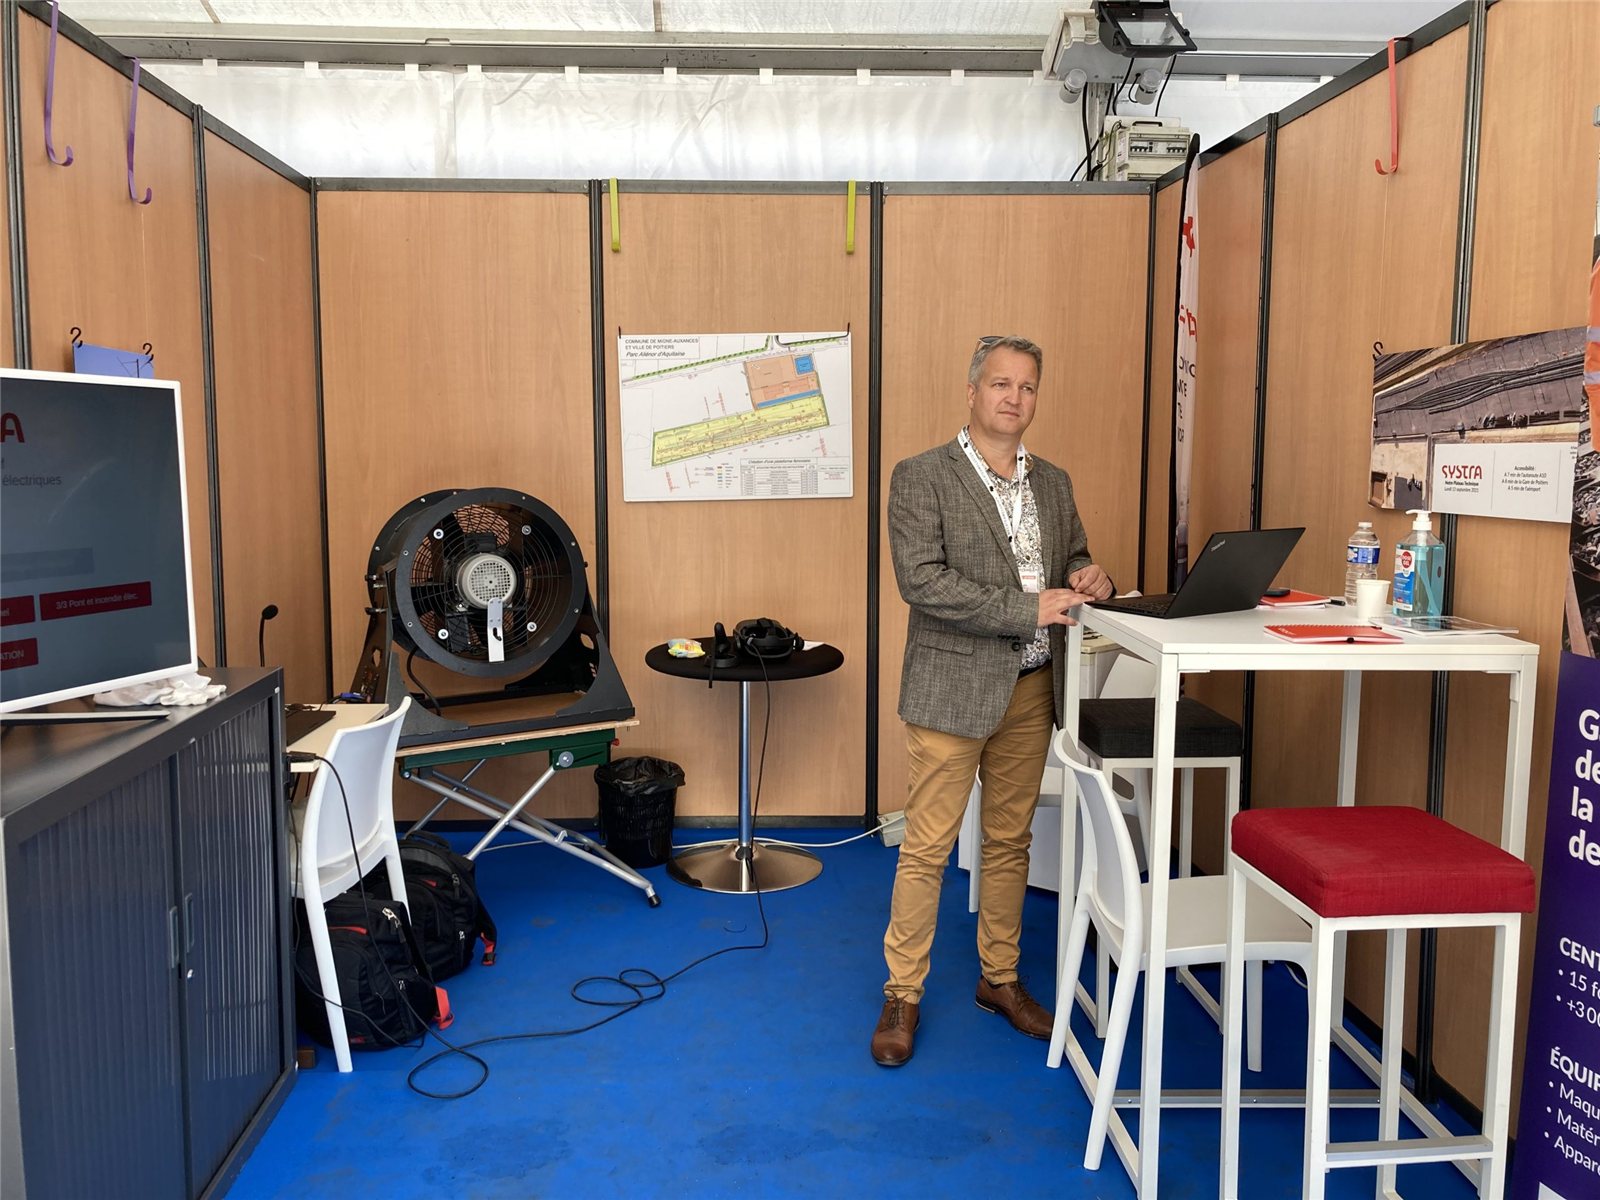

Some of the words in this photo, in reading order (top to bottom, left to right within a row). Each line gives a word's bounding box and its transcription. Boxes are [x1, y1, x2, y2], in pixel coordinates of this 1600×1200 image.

[2, 474, 63, 488] électriques
[1441, 465, 1482, 479] SYSTRA
[69, 598, 86, 608] Pont
[1578, 709, 1600, 741] G
[1571, 786, 1594, 823] la
[1568, 829, 1600, 867] de
[1569, 971, 1587, 992] 15
